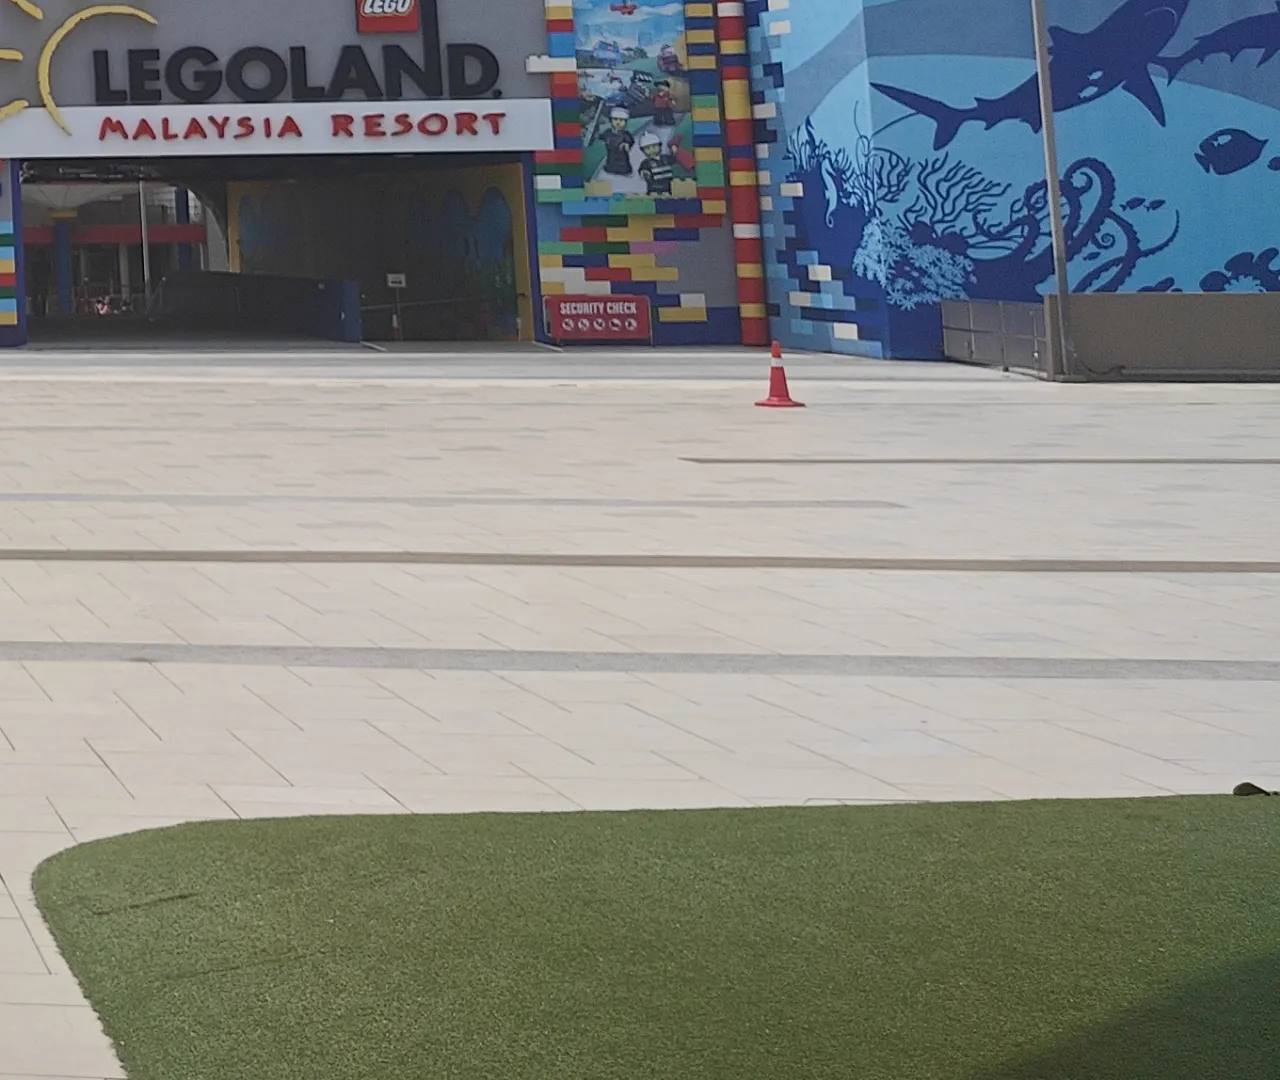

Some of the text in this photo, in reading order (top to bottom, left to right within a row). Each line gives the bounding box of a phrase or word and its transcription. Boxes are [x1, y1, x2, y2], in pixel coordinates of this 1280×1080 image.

[98, 113, 506, 140] MALAYSIA RESORT
[560, 302, 637, 315] SECURITY CHECK
